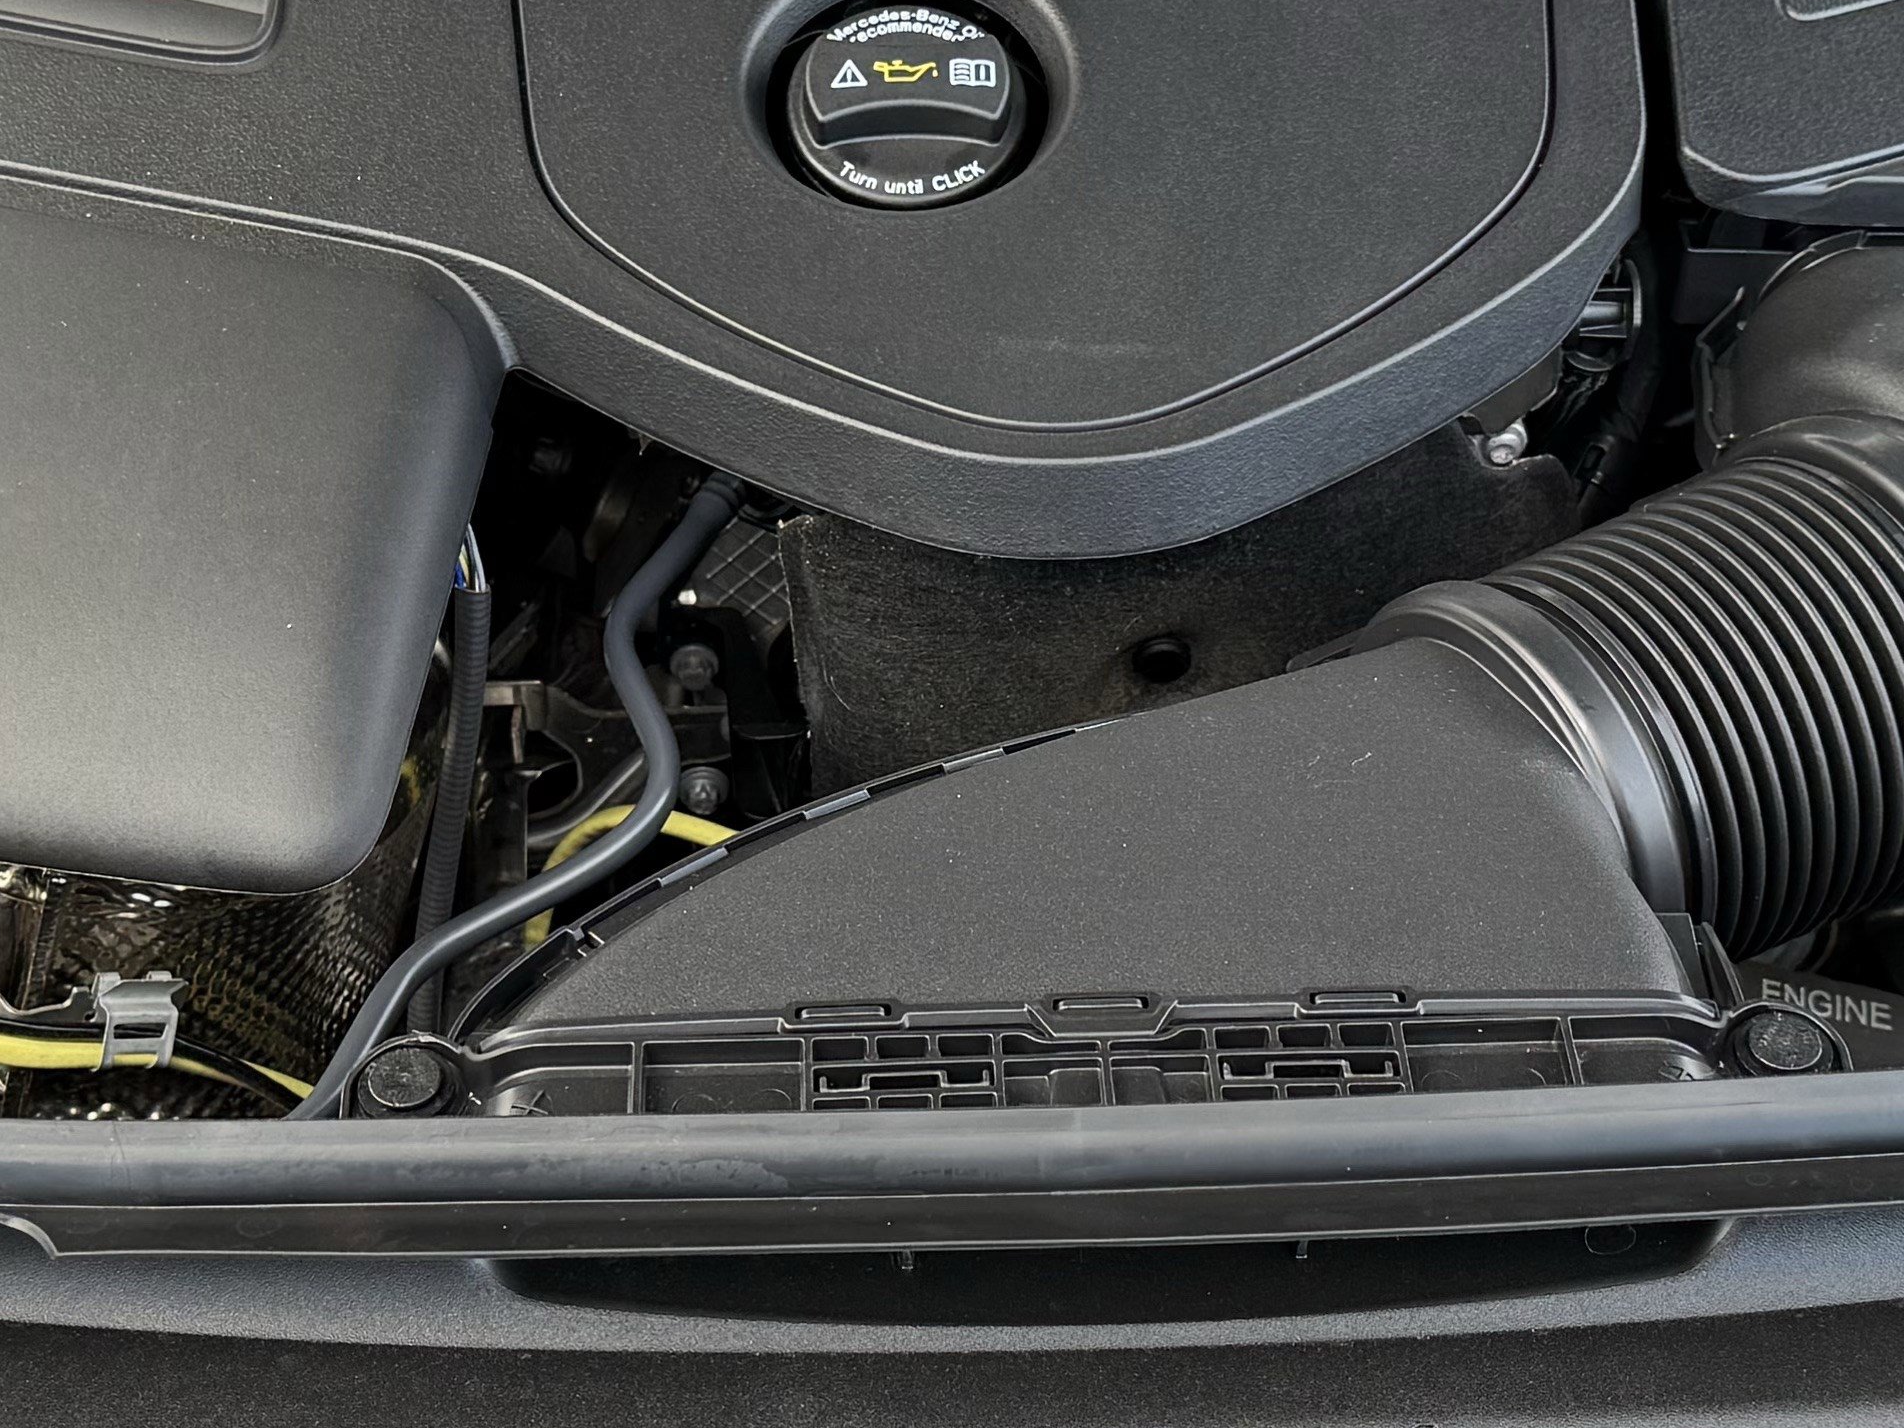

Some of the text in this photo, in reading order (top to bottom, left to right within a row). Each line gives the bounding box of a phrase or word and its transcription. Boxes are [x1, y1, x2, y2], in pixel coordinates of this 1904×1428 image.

[839, 159, 986, 195] Turn until CLICK
[1761, 977, 1893, 1032] ENGINE
